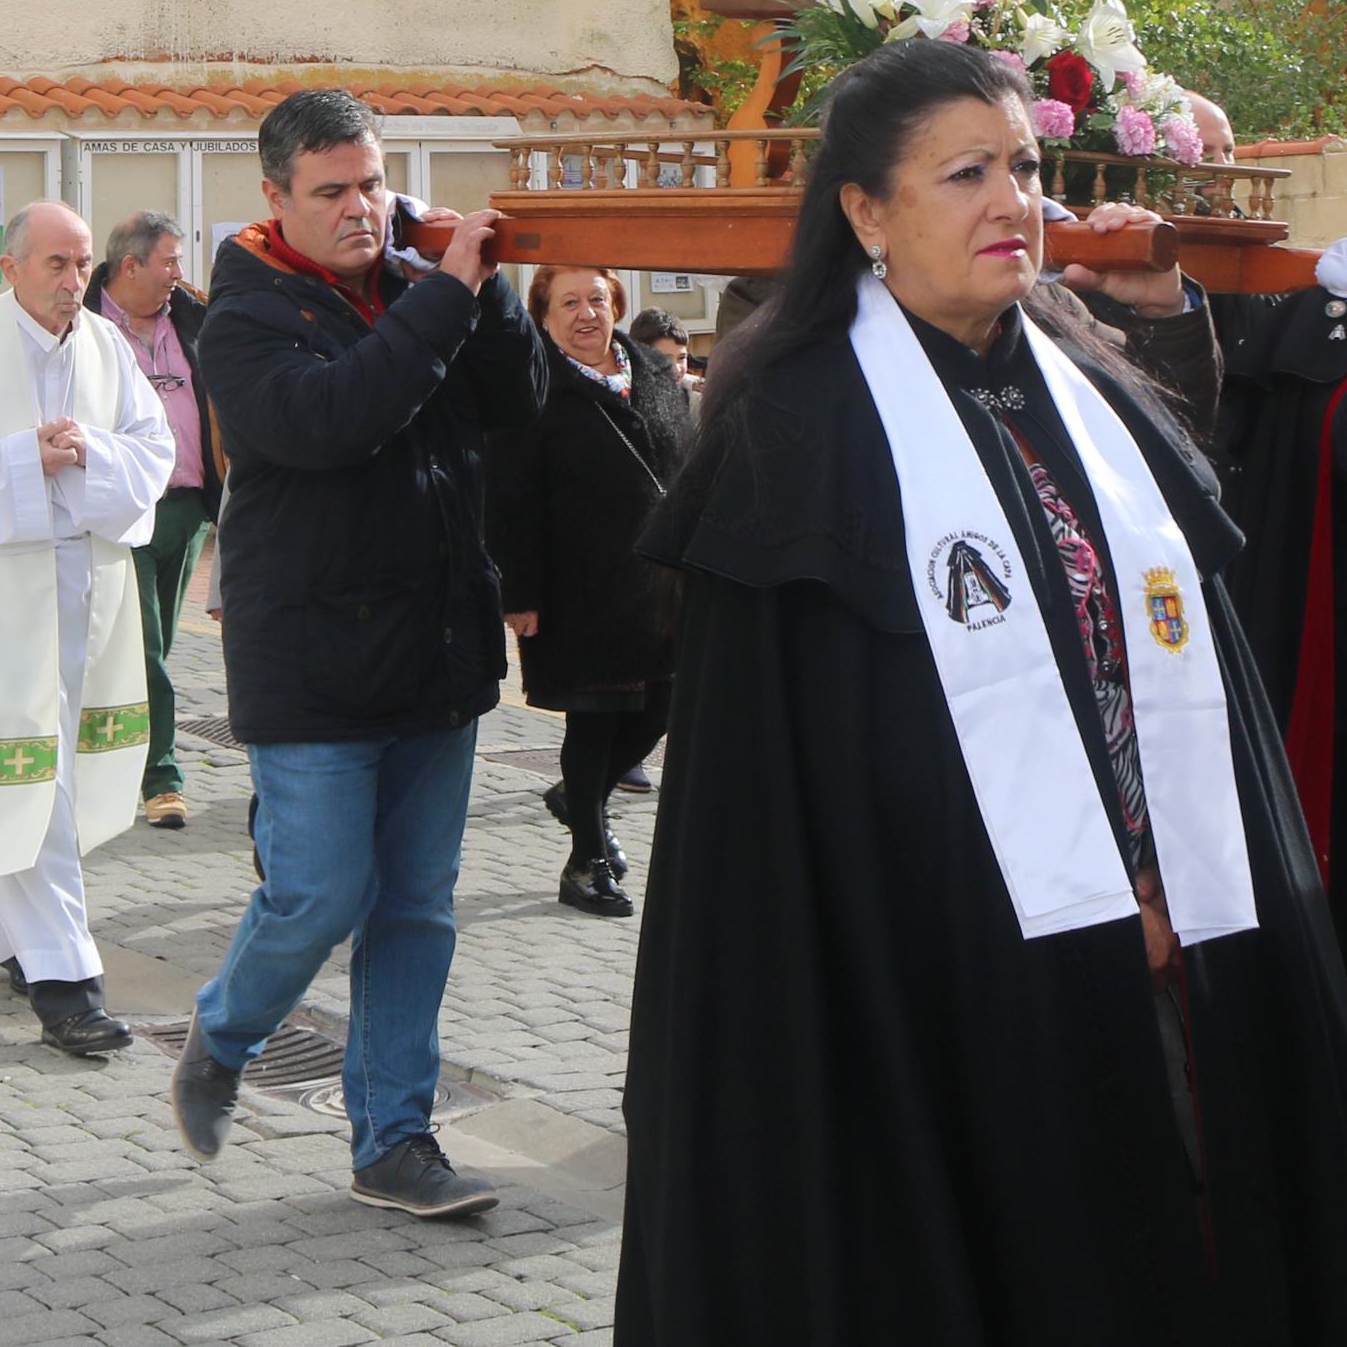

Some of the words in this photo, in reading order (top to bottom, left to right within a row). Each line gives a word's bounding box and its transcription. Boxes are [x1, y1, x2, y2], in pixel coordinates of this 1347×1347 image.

[83, 142, 118, 152] AMAS
[122, 142, 138, 152] DE
[143, 142, 175, 152] CASA
[180, 141, 188, 152] Y
[193, 141, 258, 152] JUBILADOS
[967, 615, 1006, 632] PALENCIA
